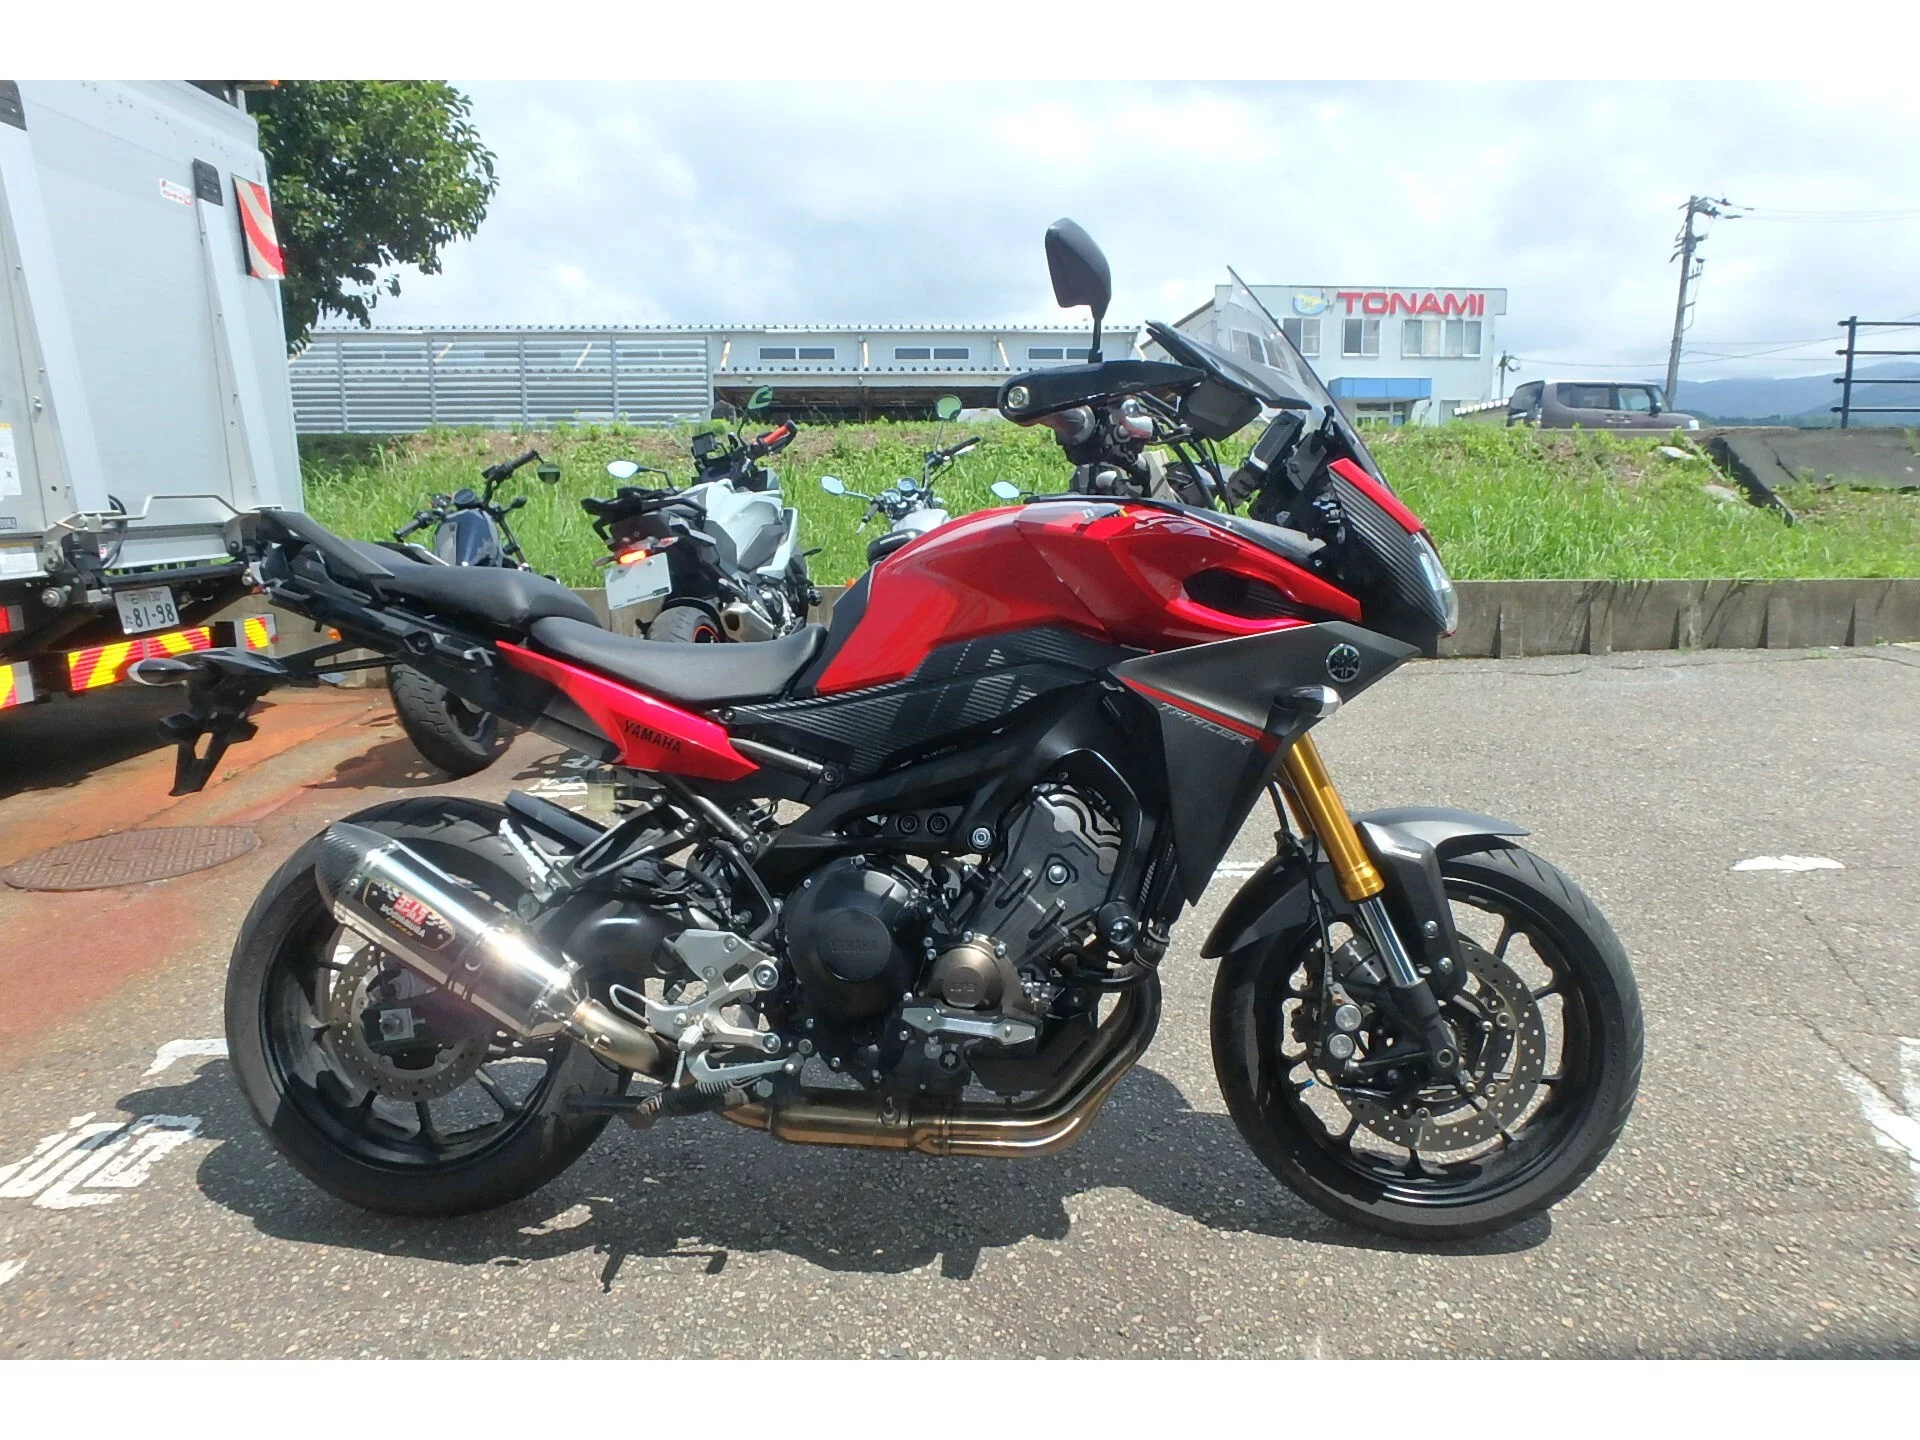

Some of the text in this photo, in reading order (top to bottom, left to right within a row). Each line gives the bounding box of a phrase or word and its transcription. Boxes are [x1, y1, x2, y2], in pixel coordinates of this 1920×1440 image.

[1336, 291, 1485, 316] TONAMI
[133, 603, 175, 628] 81-98
[624, 720, 681, 753] YAMAHA
